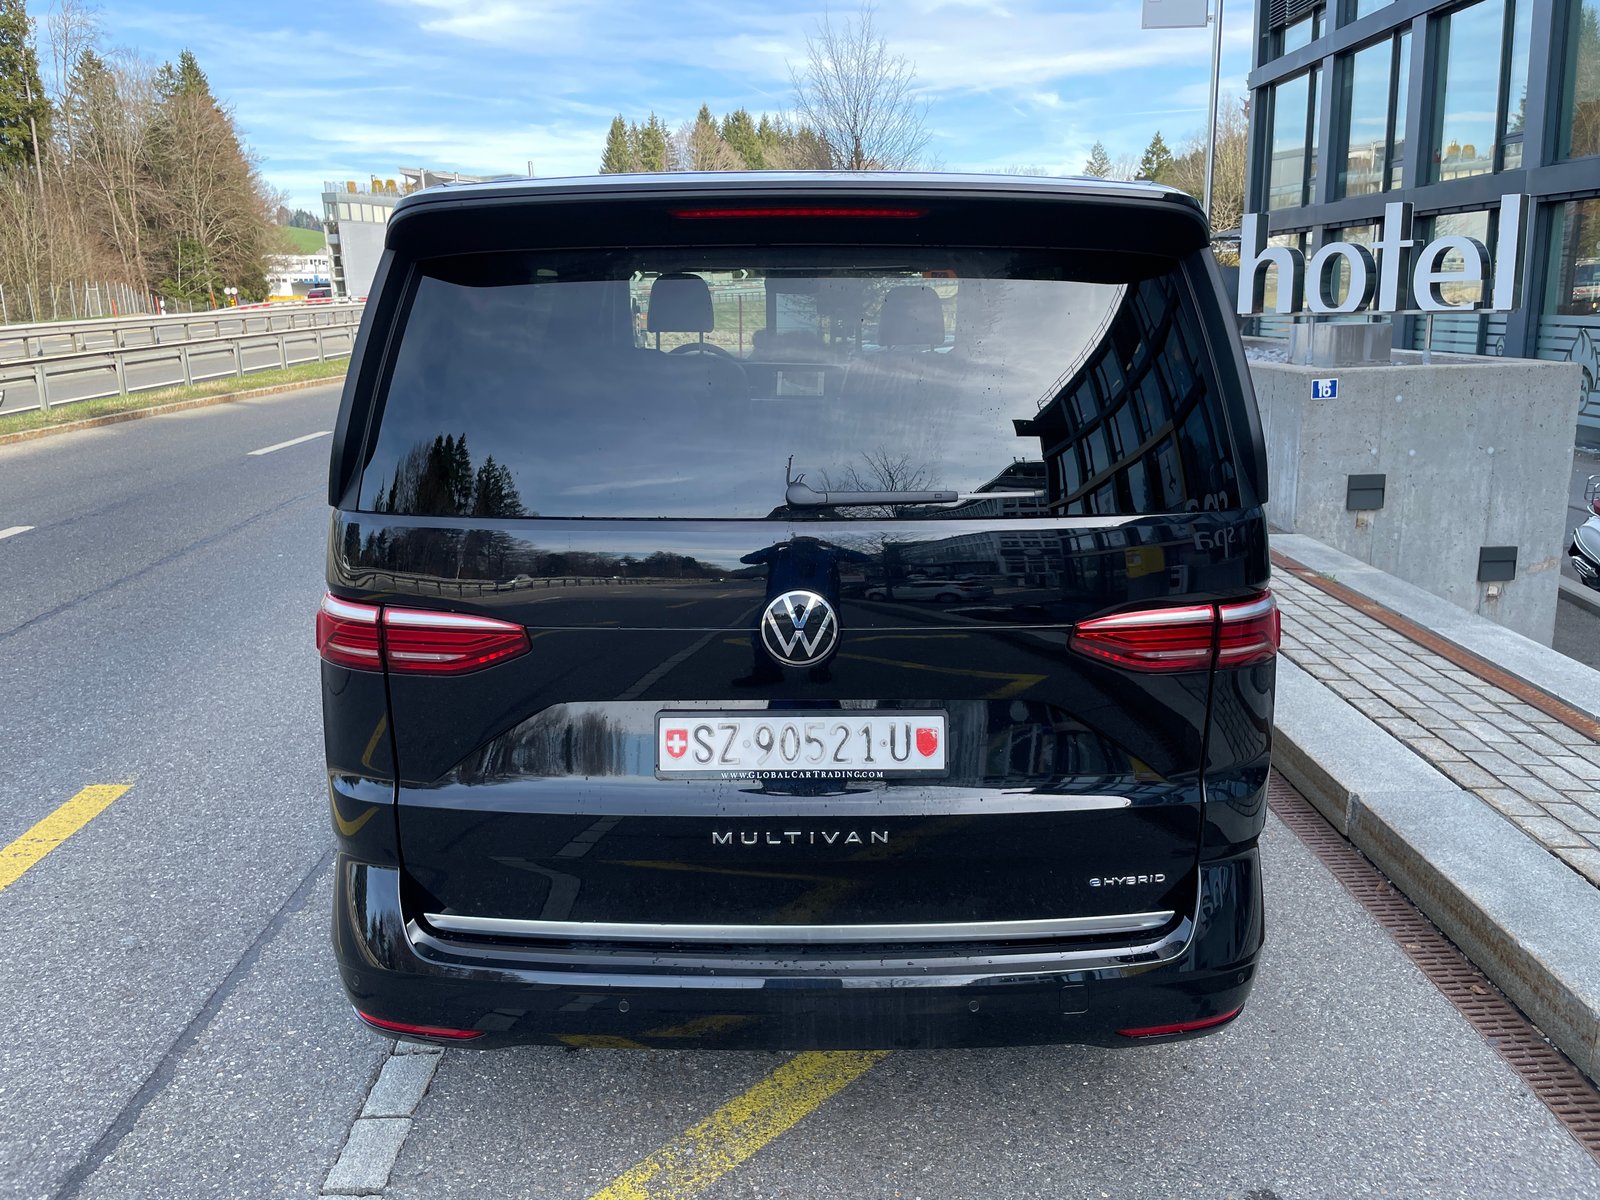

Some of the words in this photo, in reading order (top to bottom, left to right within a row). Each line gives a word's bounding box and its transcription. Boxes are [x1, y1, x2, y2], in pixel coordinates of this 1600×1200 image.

[1237, 194, 1530, 314] hotel
[765, 592, 835, 658] VW
[711, 831, 889, 845] MULTIVAN
